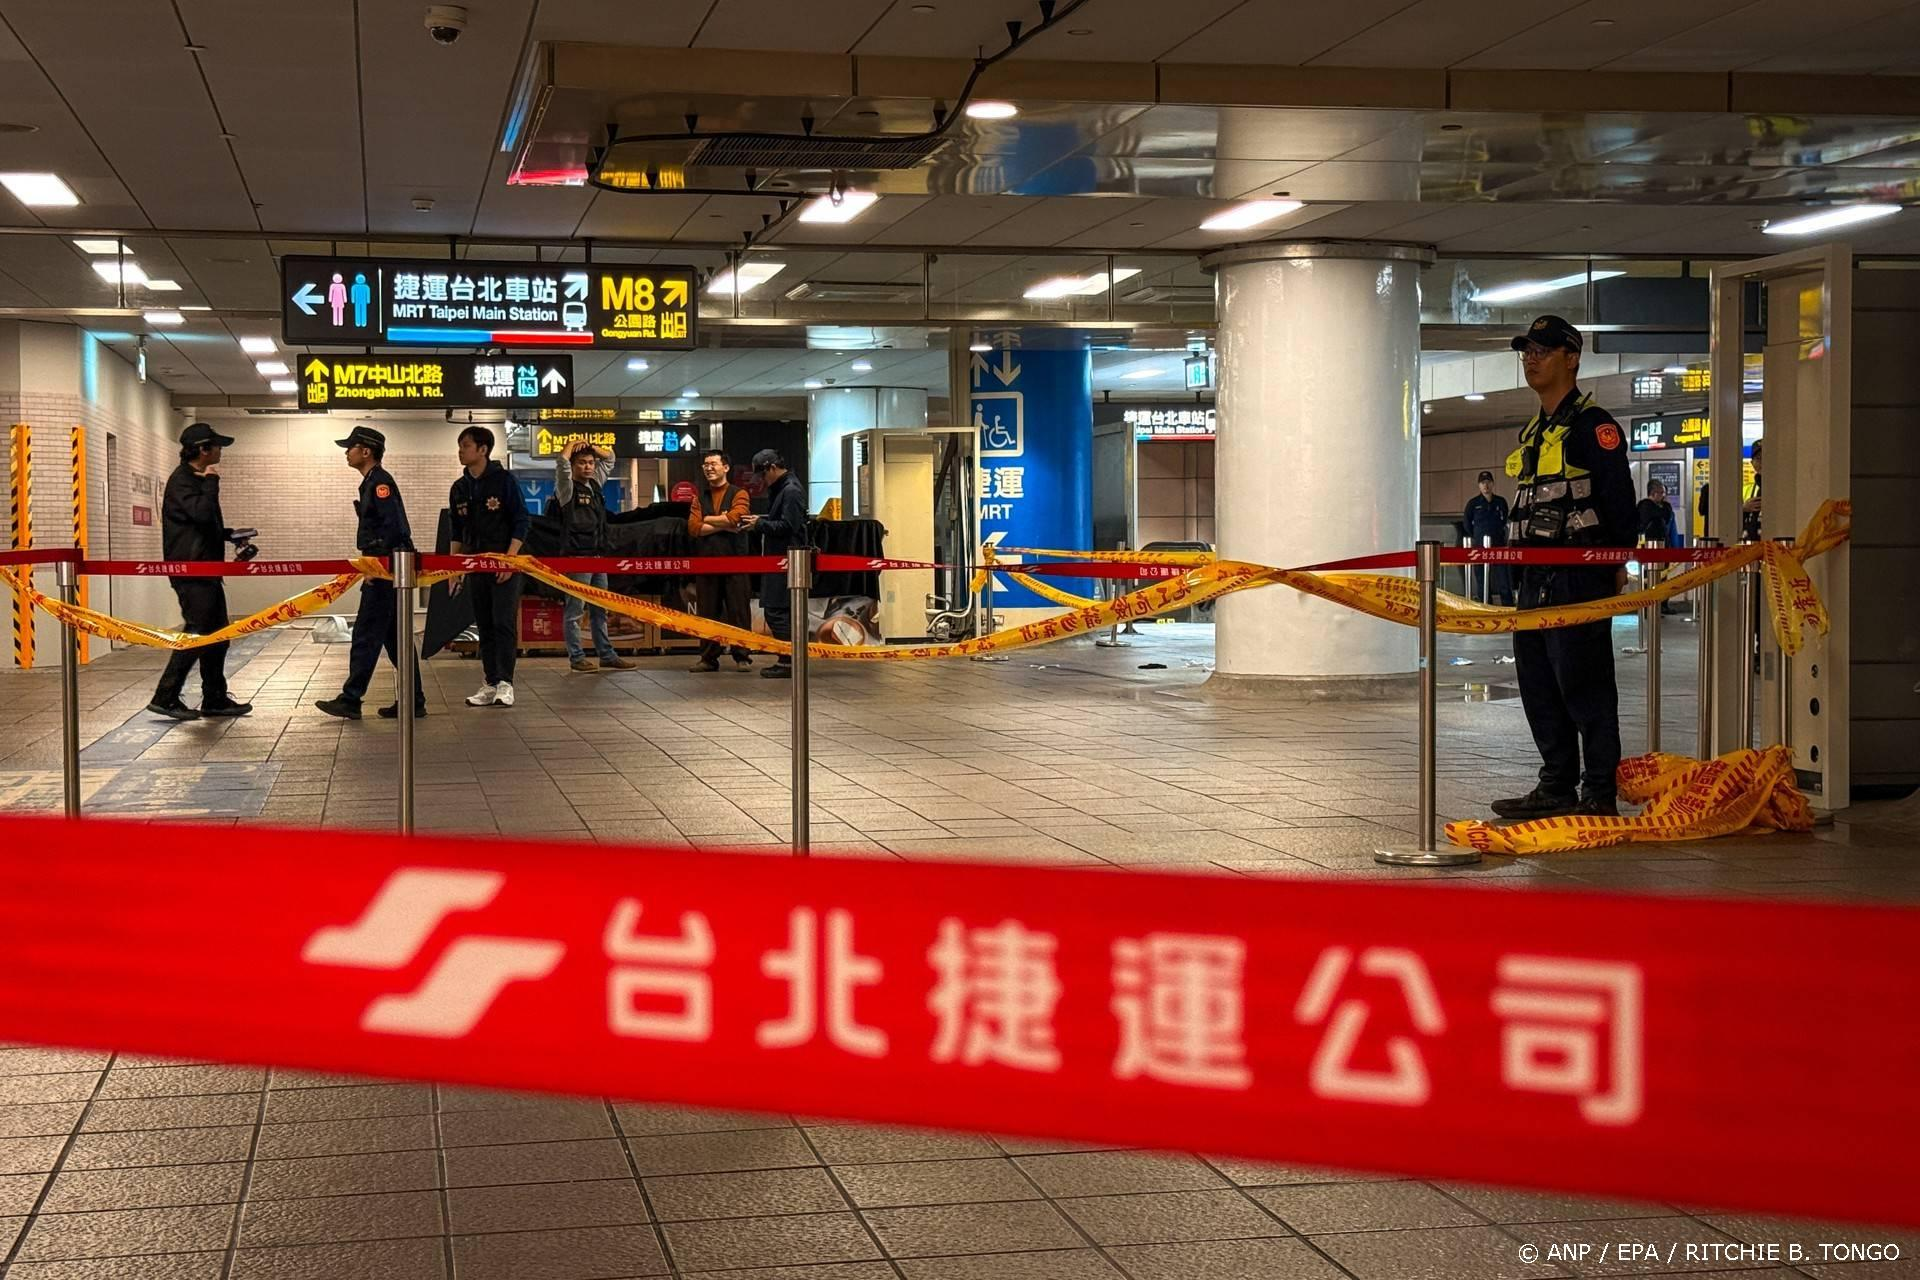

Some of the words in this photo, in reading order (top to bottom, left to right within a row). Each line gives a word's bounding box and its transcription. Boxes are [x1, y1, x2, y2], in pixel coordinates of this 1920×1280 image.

[394, 273, 557, 303] 捷運台北車站
[602, 277, 655, 311] M8
[393, 304, 426, 318] MRT
[429, 305, 469, 321] Taipei
[473, 306, 506, 320] Main
[509, 307, 558, 321] Station
[614, 314, 656, 328] 公園路
[333, 364, 443, 384] M7中山北路
[474, 365, 514, 385] 捷運
[335, 386, 403, 399] Zhongshan
[407, 386, 420, 397] N.
[423, 386, 444, 397] Rd.
[485, 386, 514, 397] MRT
[604, 897, 1646, 1127] 台北捷運公司
